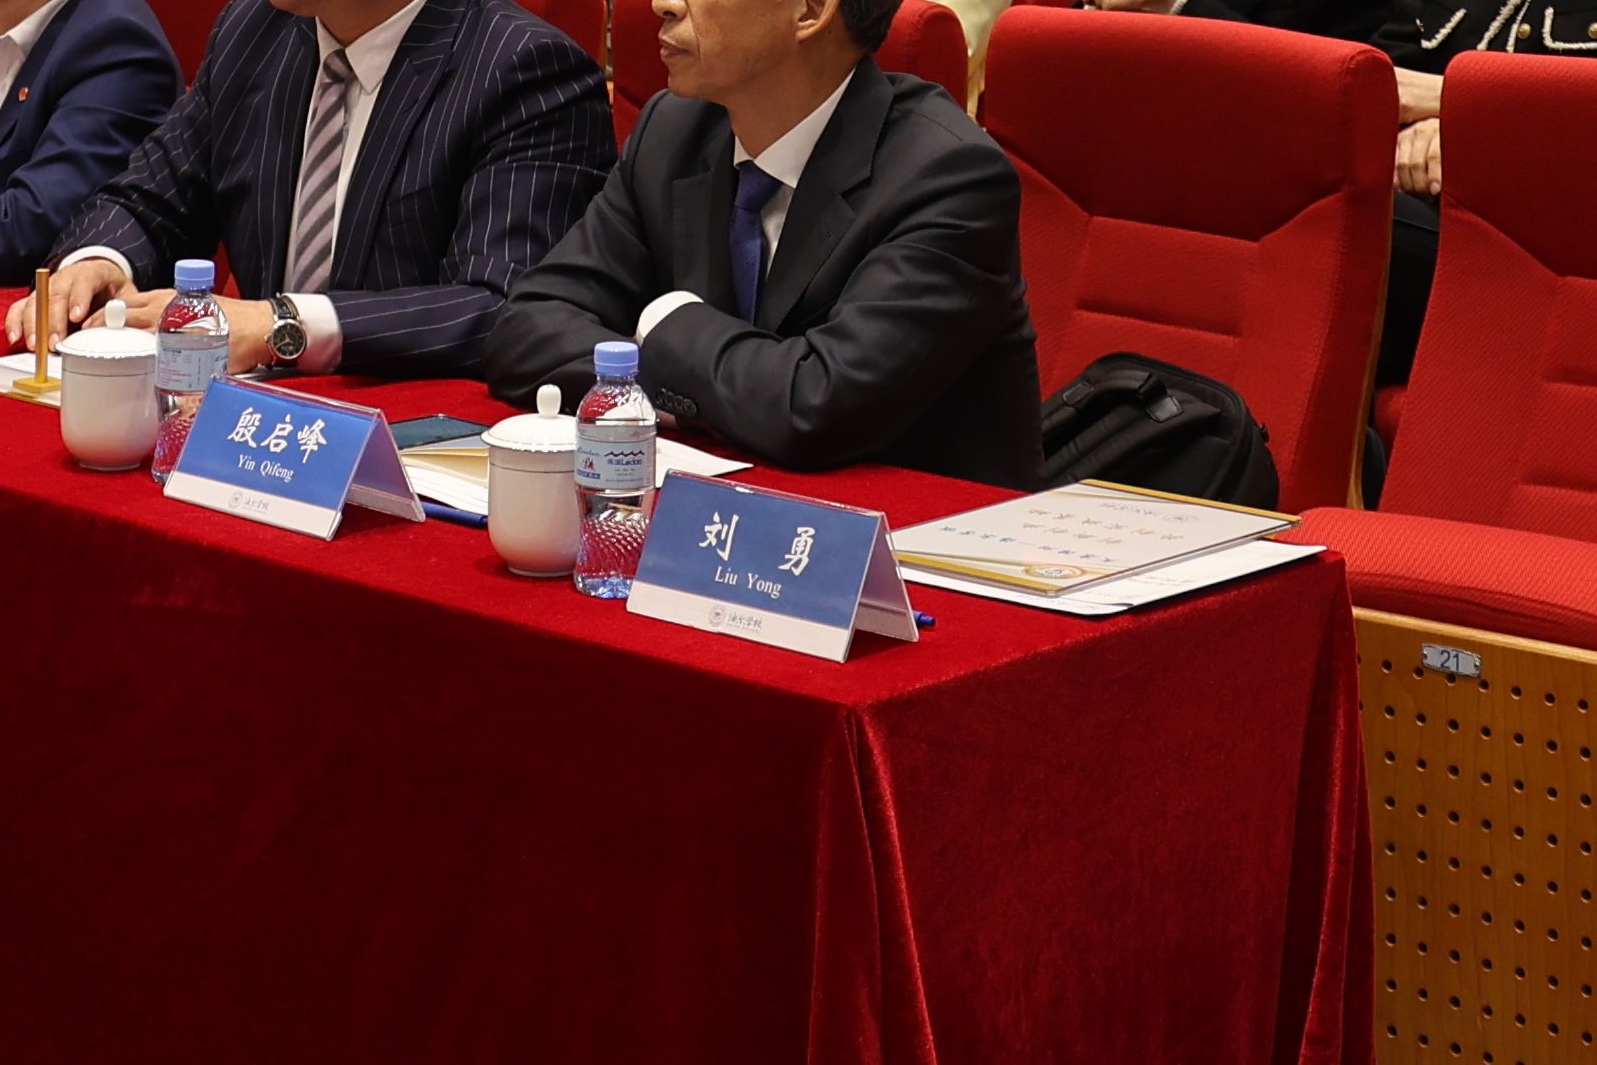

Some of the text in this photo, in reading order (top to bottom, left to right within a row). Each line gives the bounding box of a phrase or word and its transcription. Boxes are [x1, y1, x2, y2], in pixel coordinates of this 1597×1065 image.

[227, 407, 328, 464] 殷启峰
[238, 454, 294, 483] Yin Qifeng
[715, 566, 782, 599] Liu Yong
[1440, 649, 1459, 672] 21
